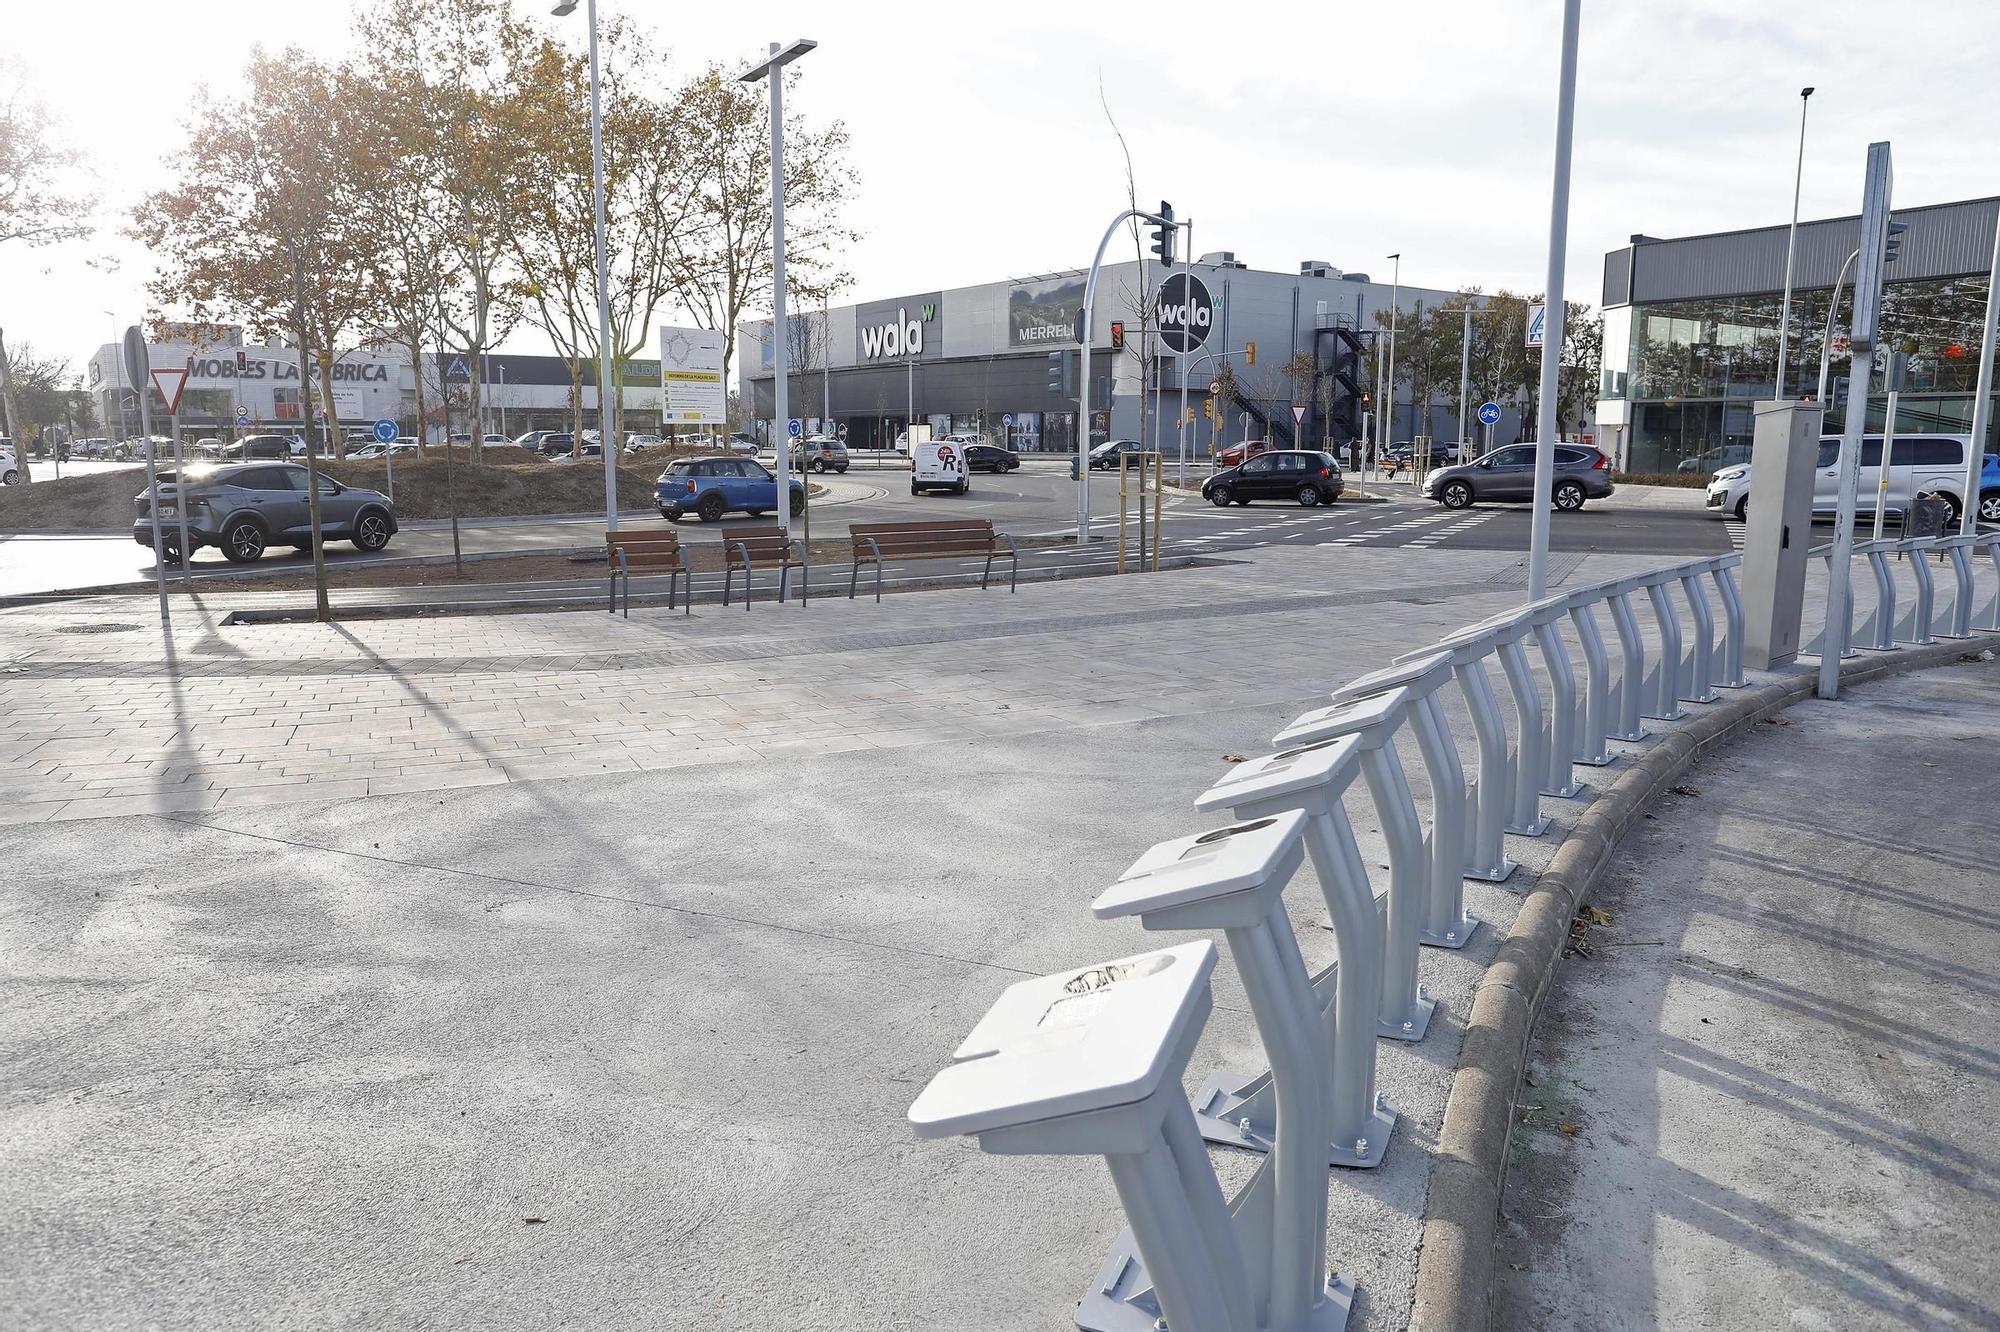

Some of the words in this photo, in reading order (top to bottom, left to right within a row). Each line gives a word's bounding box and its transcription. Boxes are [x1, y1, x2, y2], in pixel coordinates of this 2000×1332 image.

[1157, 297, 1210, 327] wala
[861, 307, 923, 359] wala
[273, 362, 300, 380] LA
[310, 362, 388, 382] FBRICA
[622, 363, 660, 377] ALDI
[942, 455, 957, 471] R
